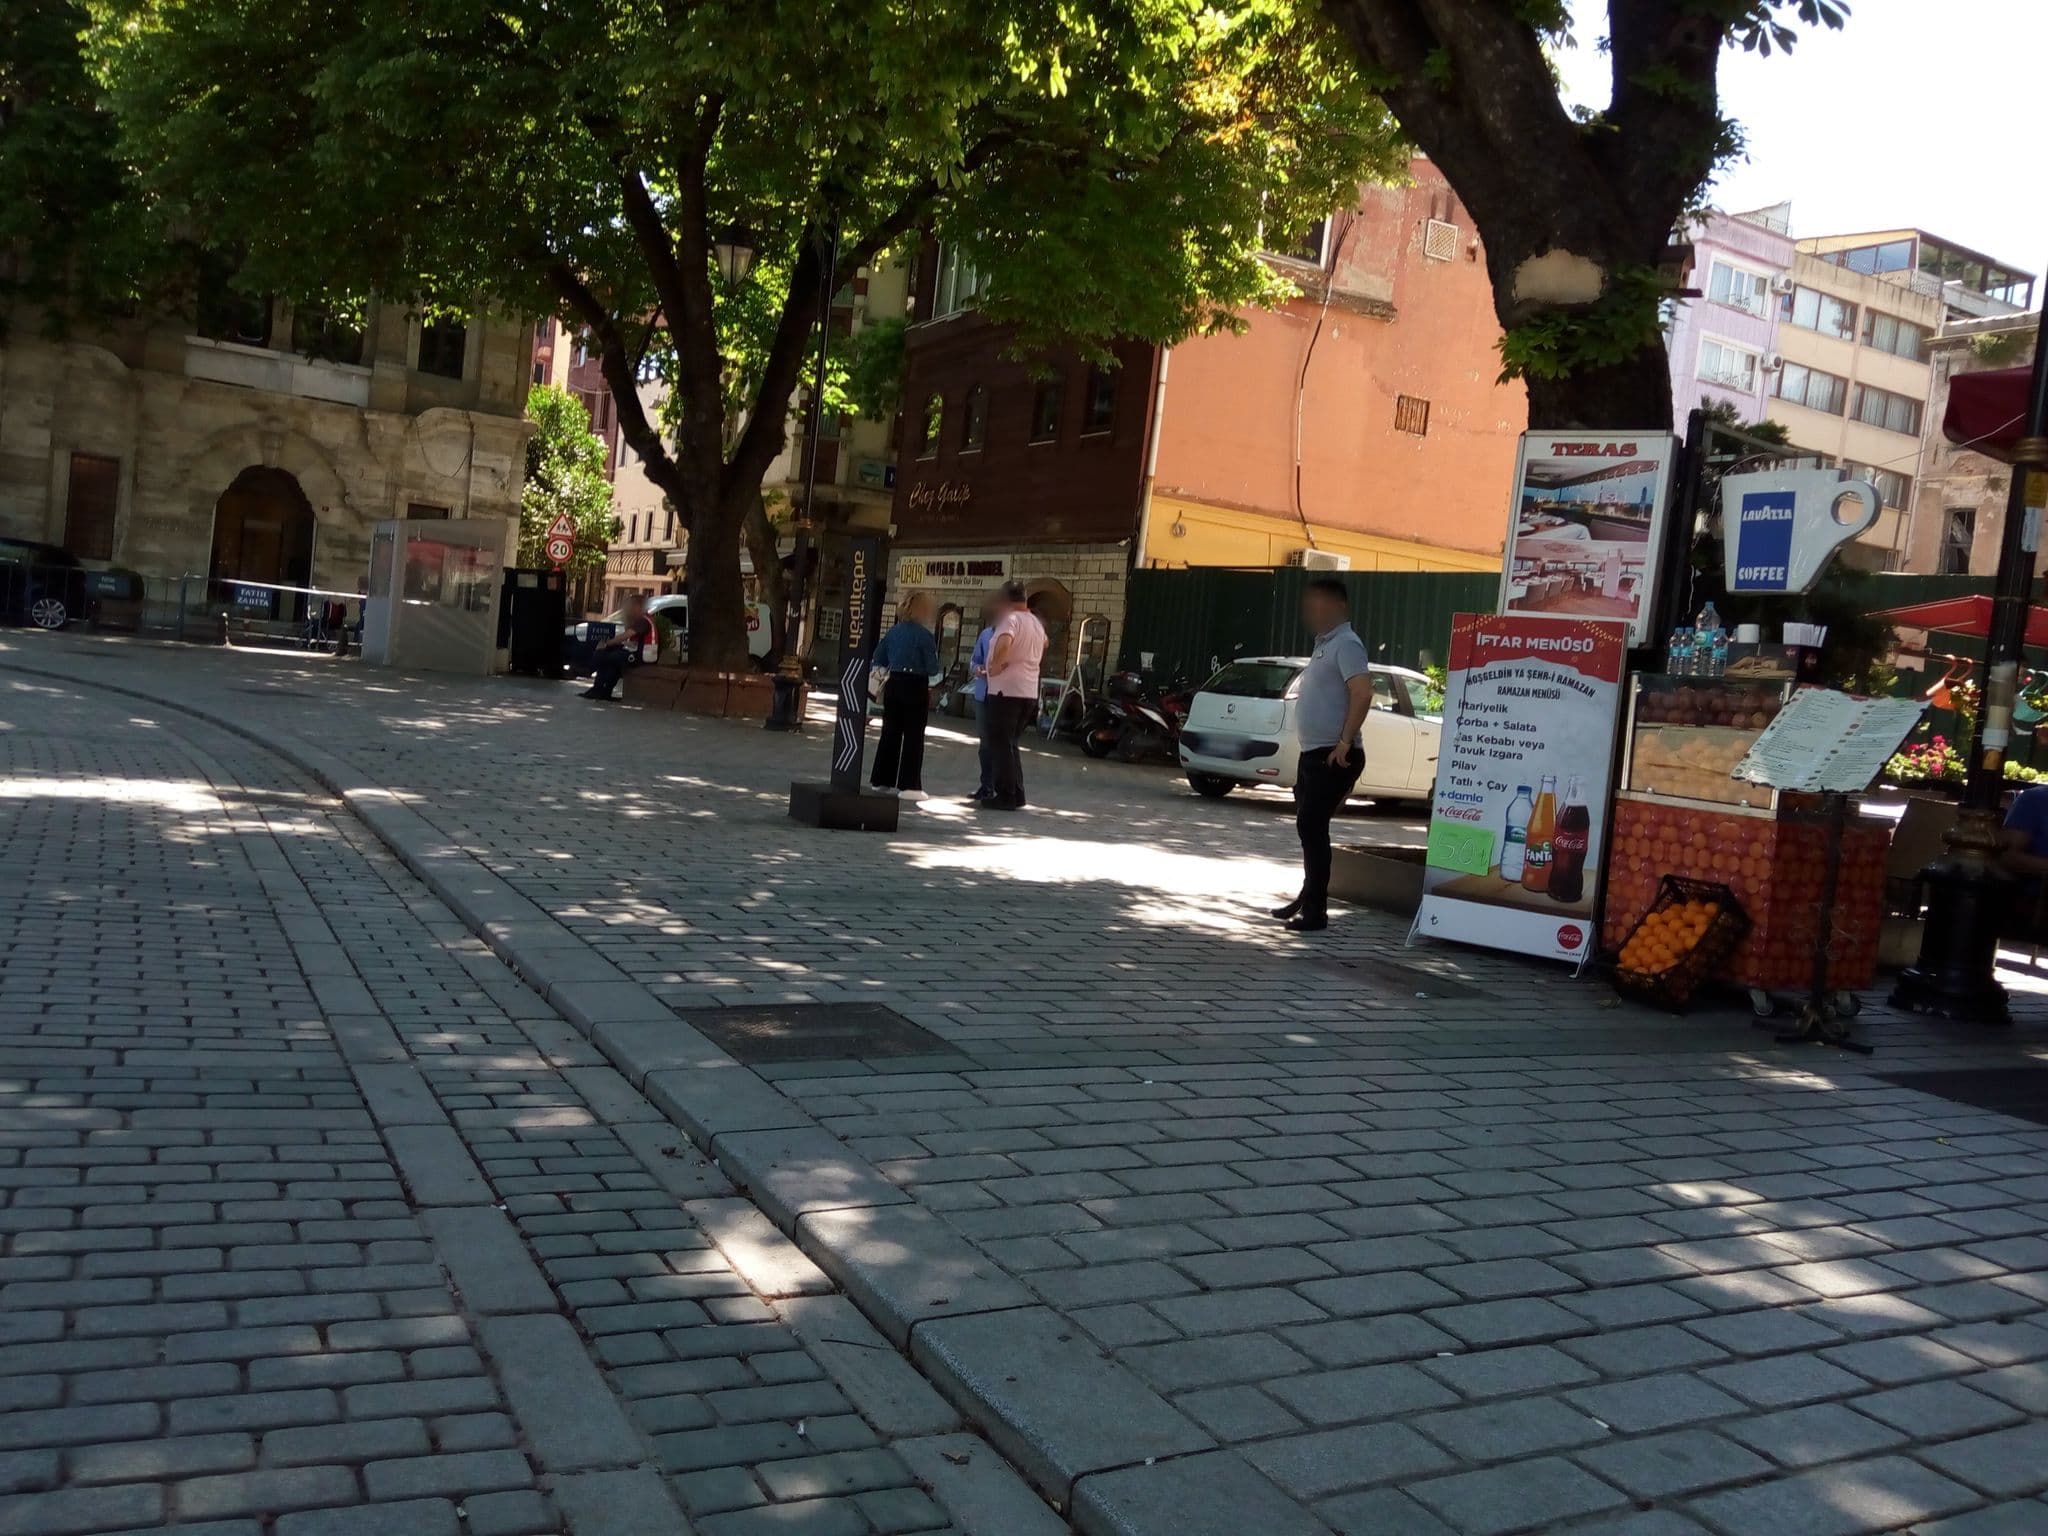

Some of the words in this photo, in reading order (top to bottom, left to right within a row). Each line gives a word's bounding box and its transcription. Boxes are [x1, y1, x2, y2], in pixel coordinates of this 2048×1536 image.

[1551, 442, 1638, 457] TERAS
[1742, 505, 1792, 521] LAVAZZA
[553, 543, 568, 555] 20
[1738, 566, 1785, 581] COFFEE
[1477, 632, 1521, 649] İFTAR
[1526, 636, 1594, 653] MENÜSÜ
[1515, 669, 1525, 678] YA
[1557, 674, 1596, 698] RAMAZAN
[1498, 685, 1530, 697] RAMAZAN
[1532, 687, 1560, 700] MENÜSÜ
[1456, 716, 1489, 729] Çorba
[1503, 721, 1537, 733] Salata
[1455, 732, 1473, 743] as
[1476, 734, 1515, 747] Kebabı
[1518, 740, 1545, 751] veya
[1453, 744, 1486, 757] Tavuk
[1489, 748, 1523, 761] Izgara
[1451, 760, 1477, 771] Pilav
[1450, 775, 1473, 787] Tatlı
[1487, 780, 1508, 792] Çay
